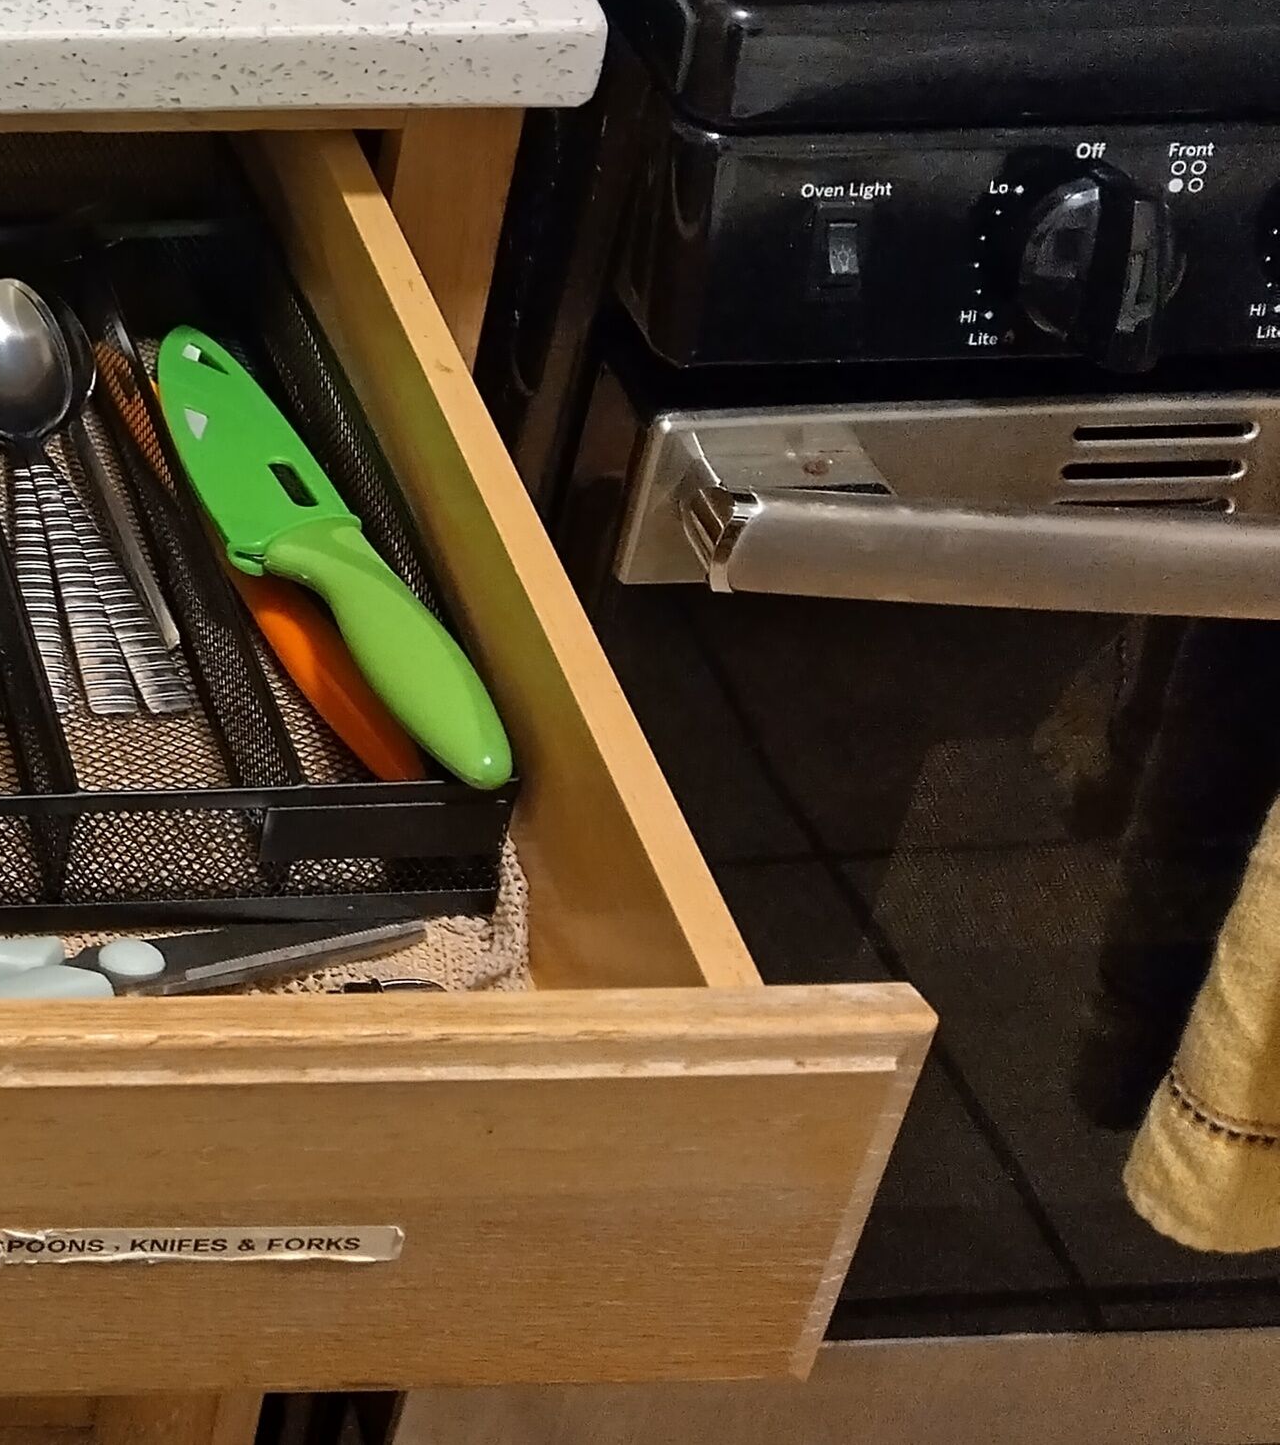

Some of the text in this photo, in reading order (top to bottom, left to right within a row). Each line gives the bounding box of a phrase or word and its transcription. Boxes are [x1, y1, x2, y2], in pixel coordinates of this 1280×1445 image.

[1076, 142, 1106, 160] Off
[1169, 142, 1214, 158] Front
[801, 182, 893, 200] Oven Light
[990, 179, 1008, 194] Lo
[960, 309, 977, 323] Hi
[969, 332, 998, 346] Lite
[130, 1238, 228, 1253] KNIFES
[237, 1239, 256, 1251] &
[267, 1237, 361, 1252] FORKS
